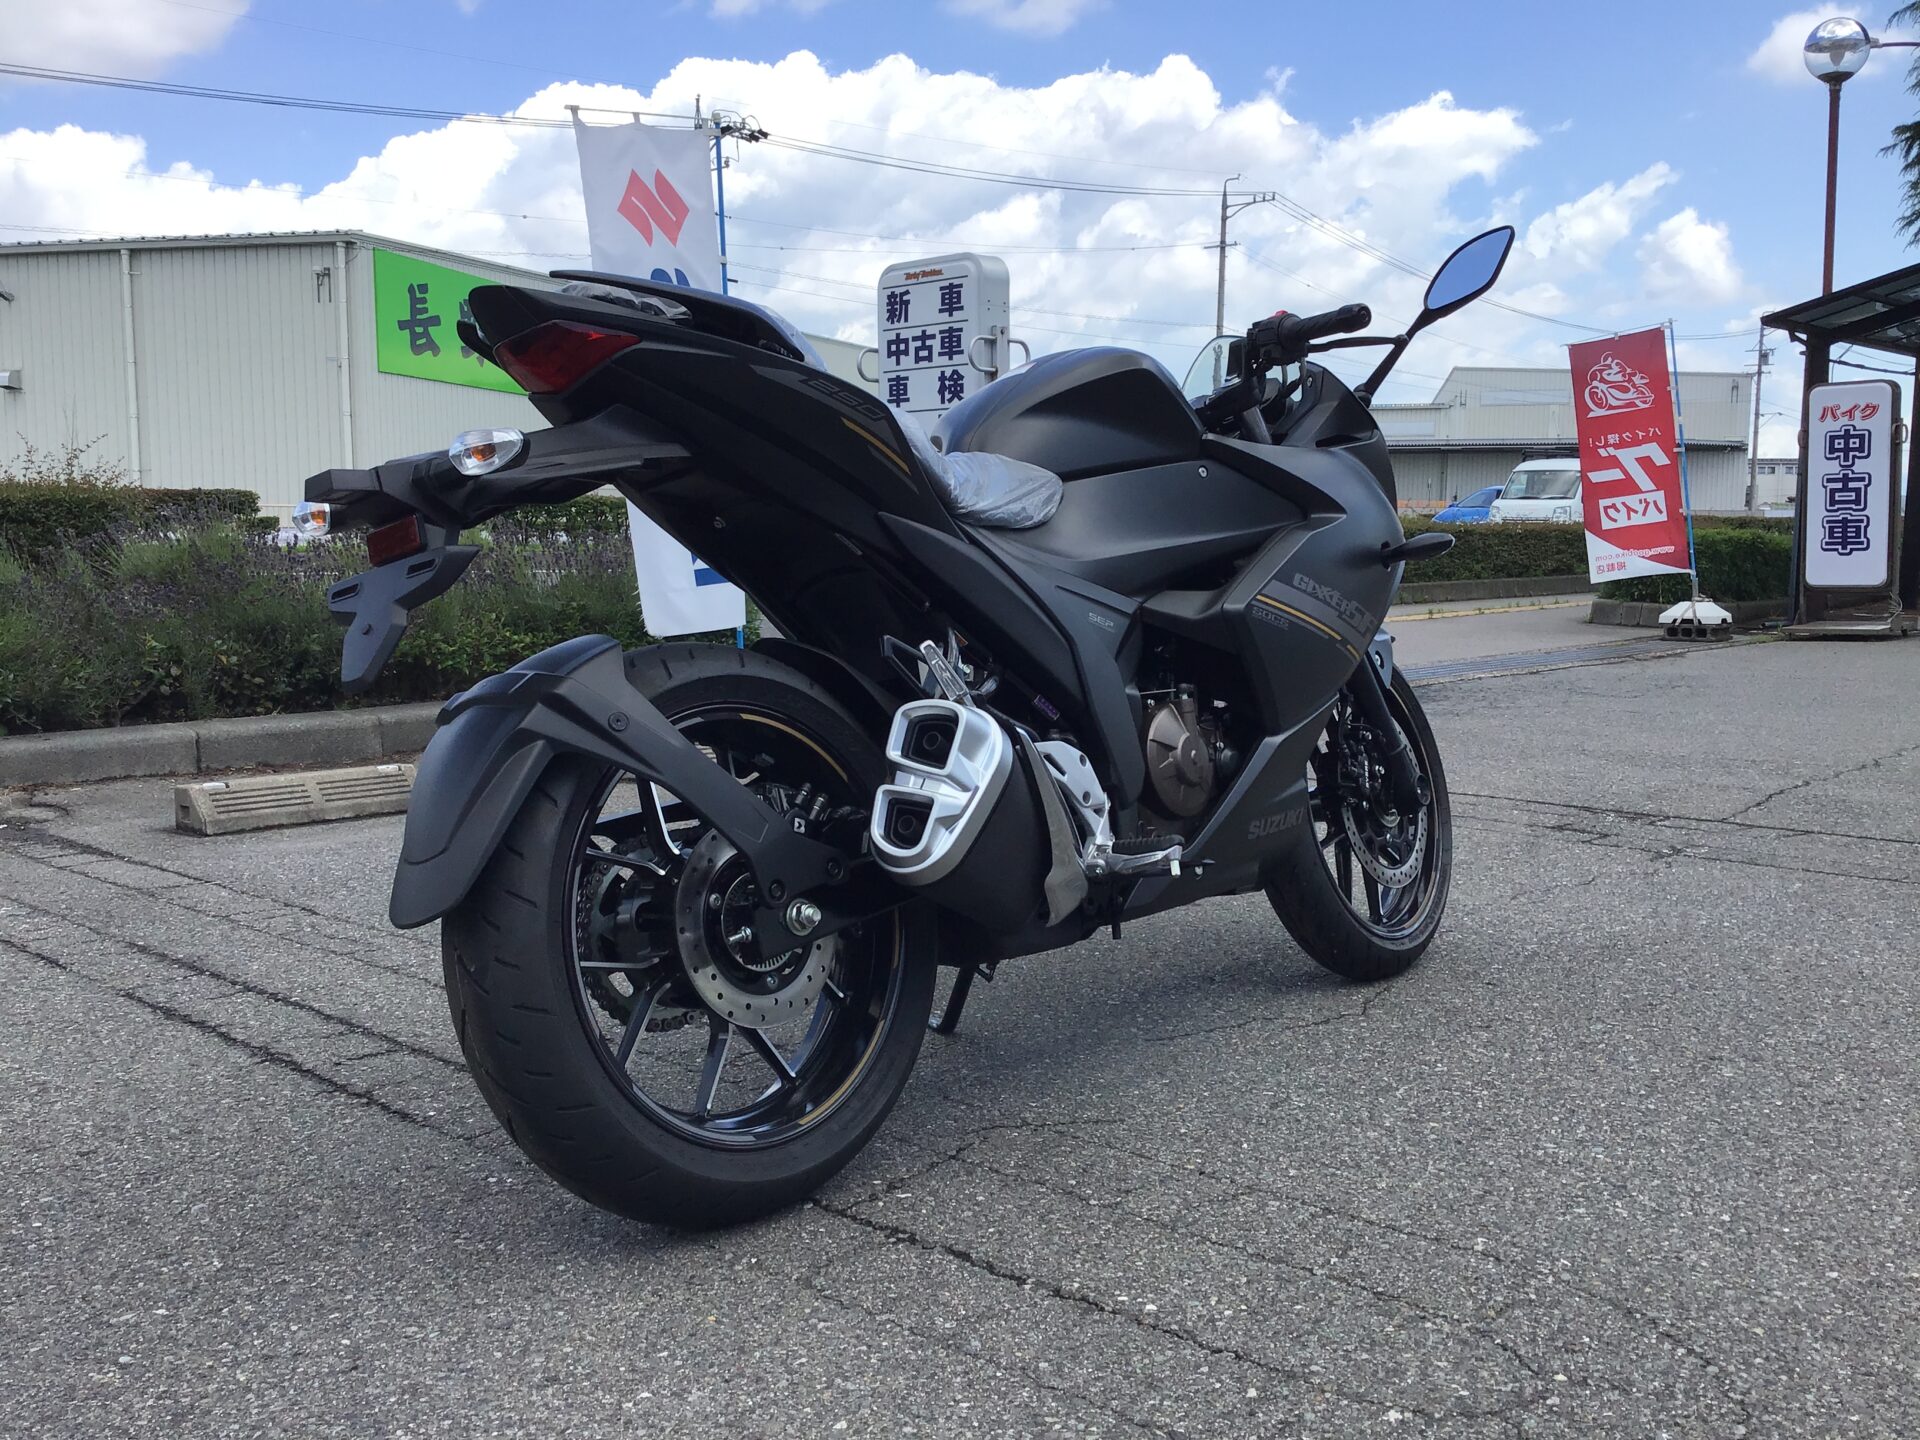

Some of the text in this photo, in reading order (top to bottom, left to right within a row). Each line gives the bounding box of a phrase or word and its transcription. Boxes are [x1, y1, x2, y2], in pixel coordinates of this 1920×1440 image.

[886, 326, 964, 366] 中古車
[806, 379, 885, 421] 250
[1818, 402, 1880, 422] バイク
[1821, 424, 1872, 556] 中古車
[1248, 807, 1304, 840] SUZUKI
